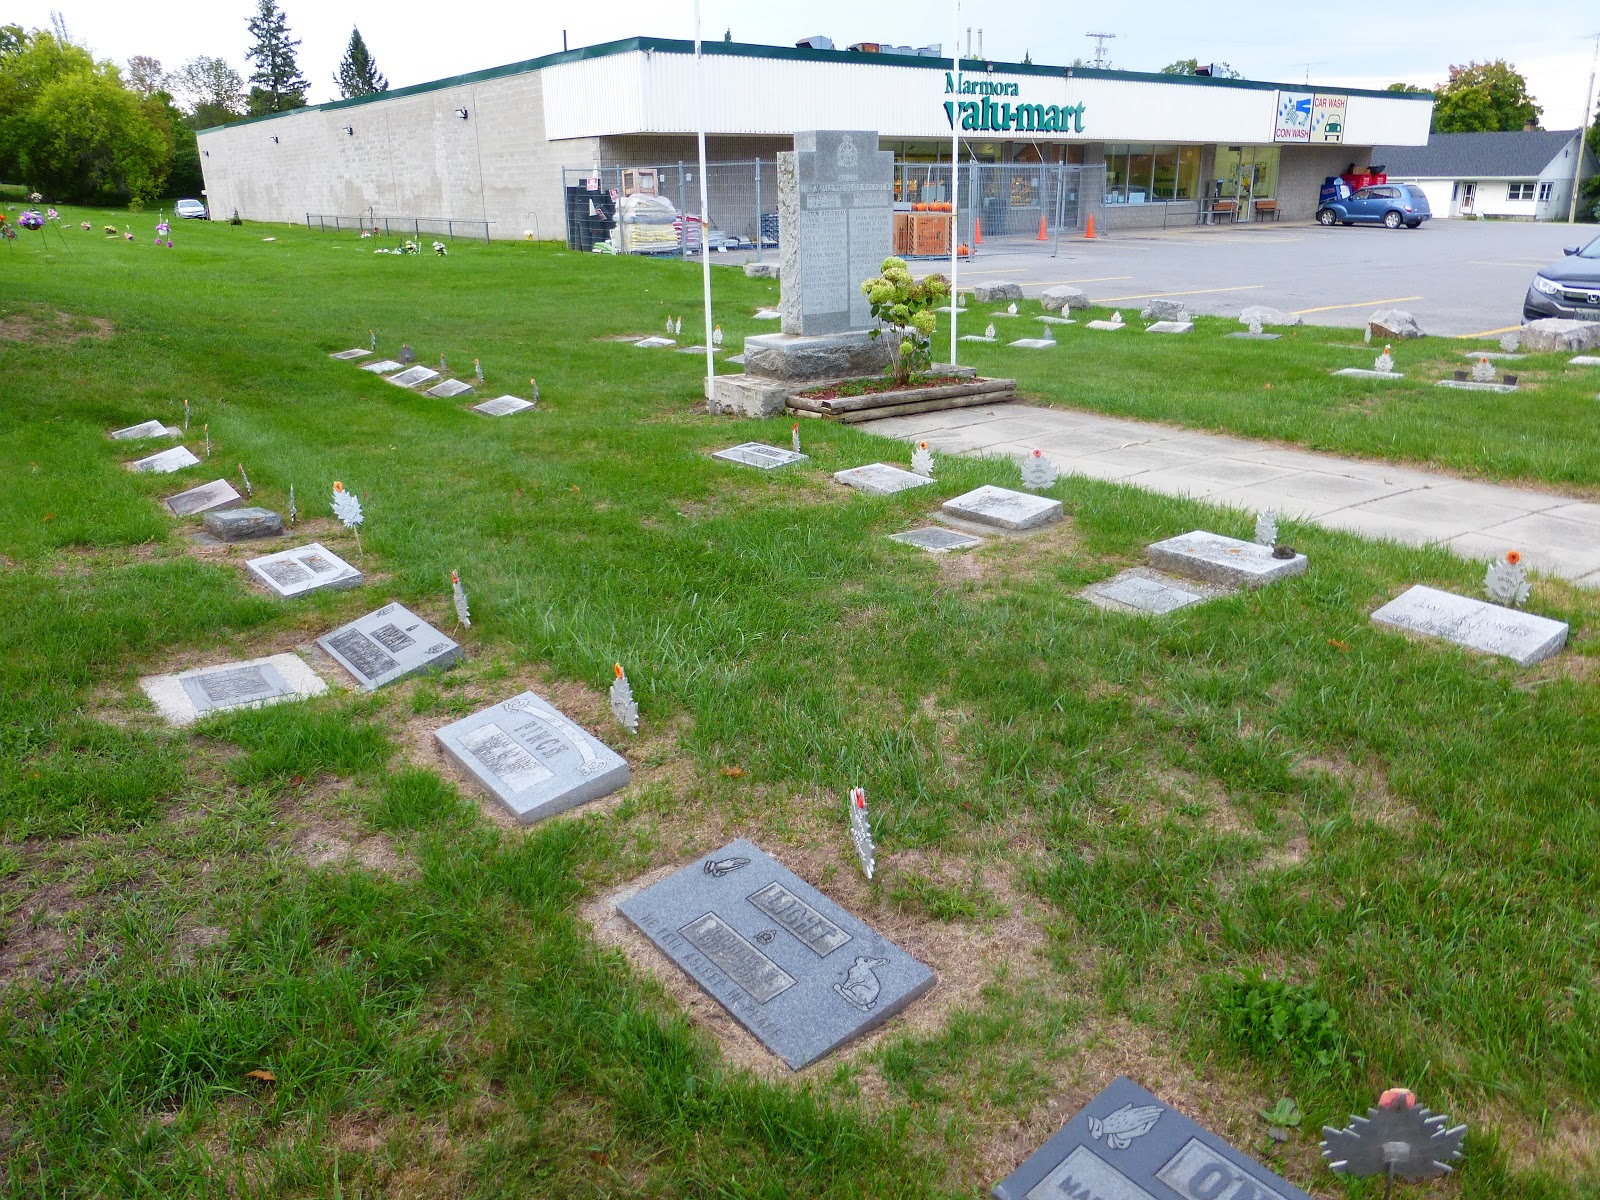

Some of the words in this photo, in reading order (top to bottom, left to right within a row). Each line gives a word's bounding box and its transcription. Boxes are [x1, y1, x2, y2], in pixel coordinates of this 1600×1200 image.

[945, 72, 1019, 96] Marmora
[1314, 98, 1327, 108] CAR
[1328, 99, 1345, 108] WASH
[1276, 128, 1291, 138] COIN
[1292, 129, 1309, 138] WASH
[514, 720, 570, 759] FINCH
[760, 888, 840, 946] LIGHT
[639, 913, 658, 928] HE
[655, 926, 684, 950] FELL
[682, 951, 727, 989] ASLEEP
[724, 988, 743, 1004] IN
[740, 1003, 784, 1040] PEACE
